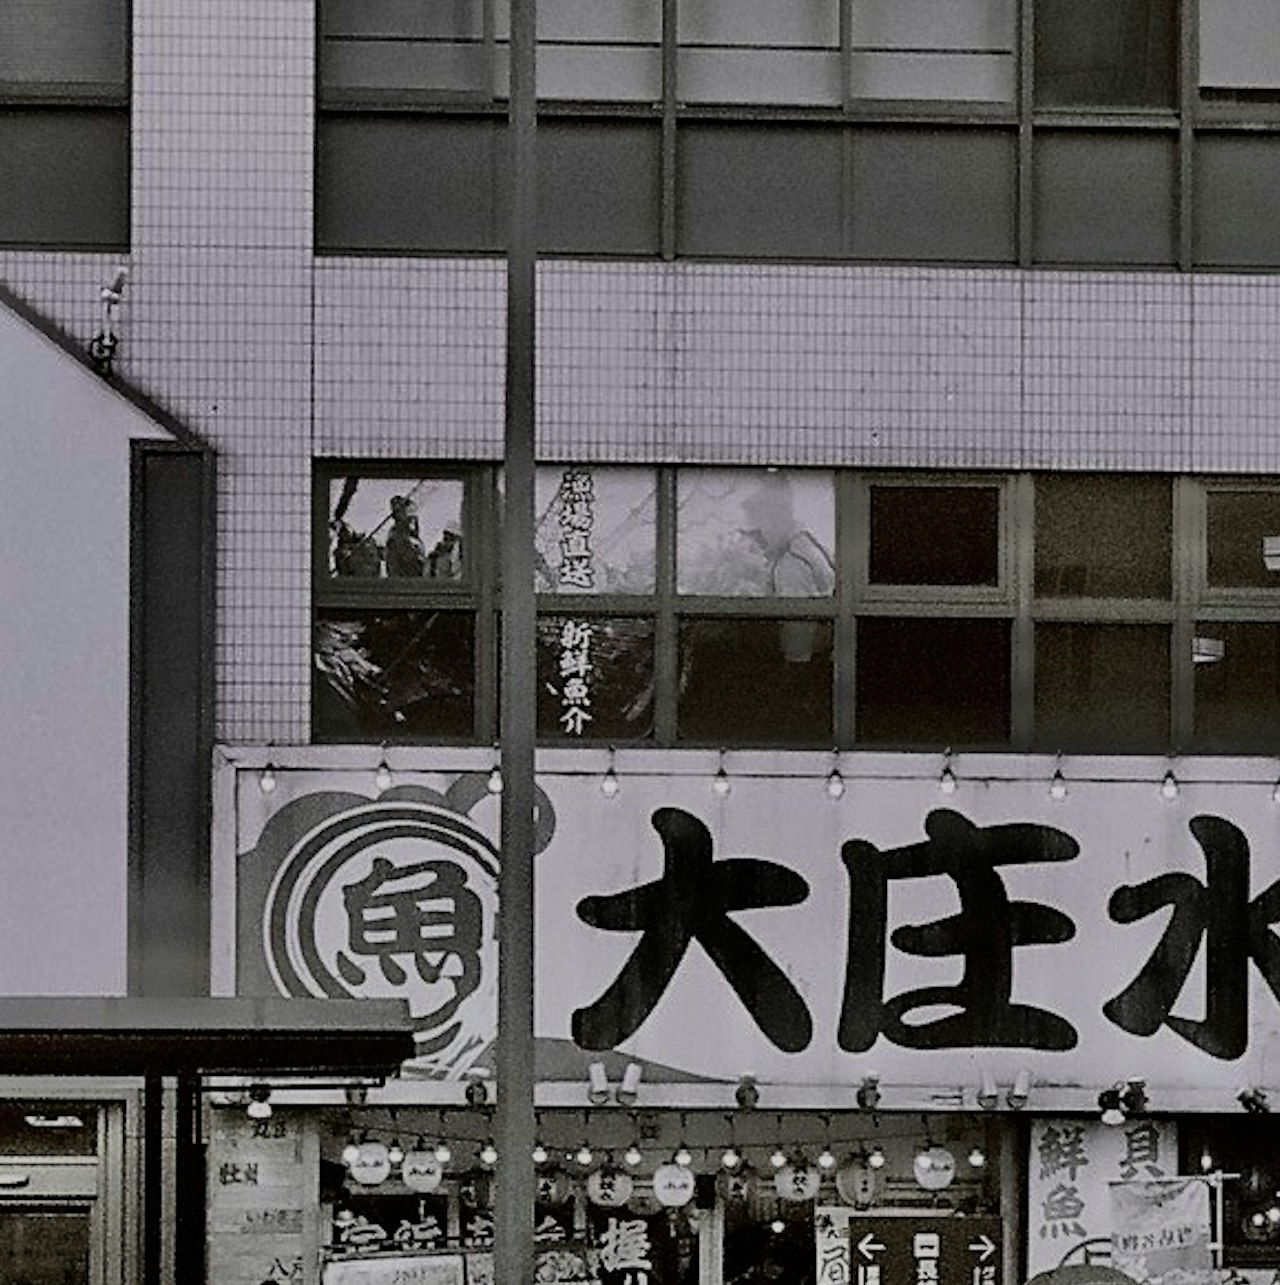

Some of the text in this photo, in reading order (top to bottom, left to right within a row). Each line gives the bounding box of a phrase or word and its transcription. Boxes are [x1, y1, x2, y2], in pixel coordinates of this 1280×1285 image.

[559, 618, 595, 736] 新鮮魚介
[1037, 1126, 1090, 1240] 鮮魚
[1119, 1124, 1165, 1179] 貝
